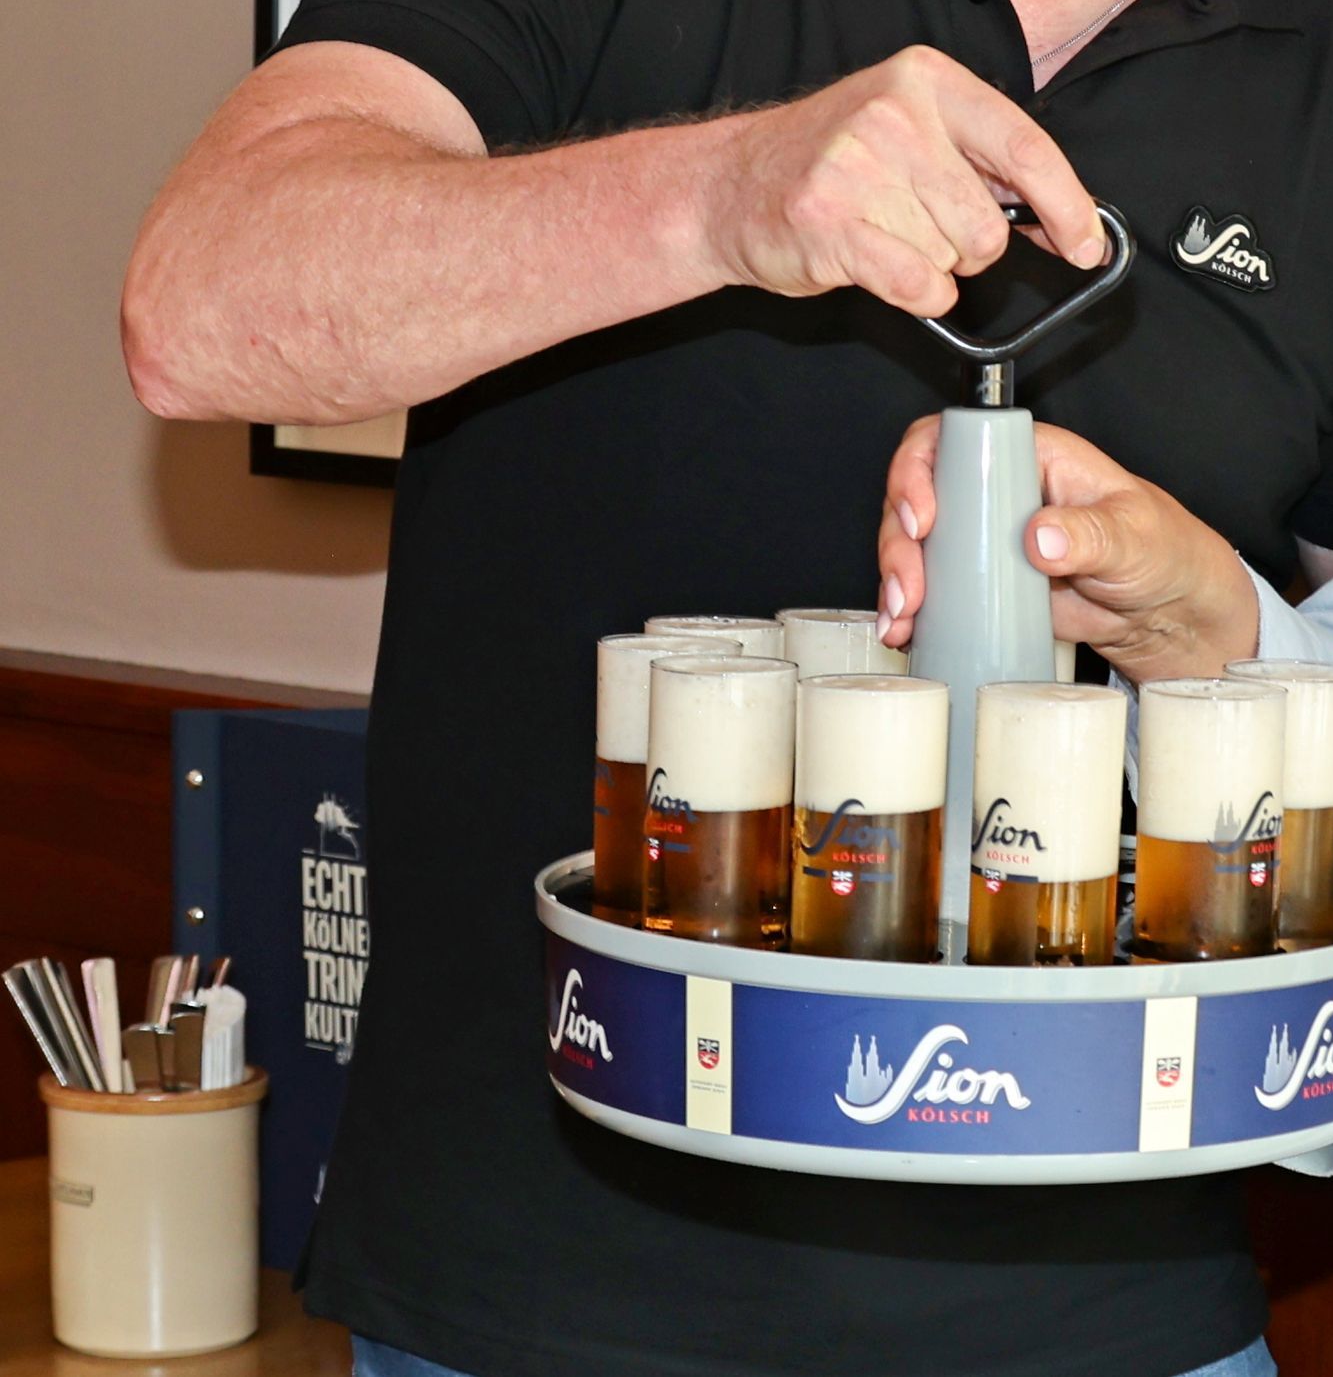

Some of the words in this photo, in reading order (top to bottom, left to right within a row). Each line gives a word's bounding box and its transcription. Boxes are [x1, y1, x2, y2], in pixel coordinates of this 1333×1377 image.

[1177, 223, 1270, 282] Sion
[1210, 261, 1253, 284] KÖLSCH
[972, 797, 1048, 854] Sion
[831, 852, 888, 865] KÖLSCH
[985, 850, 1031, 864] KÖLSCH
[302, 857, 367, 916] ECHT
[303, 909, 370, 958] KÖLNE
[549, 968, 614, 1063] Sion
[834, 1024, 1031, 1124] Sion
[907, 1106, 992, 1124] KÖLSCH
